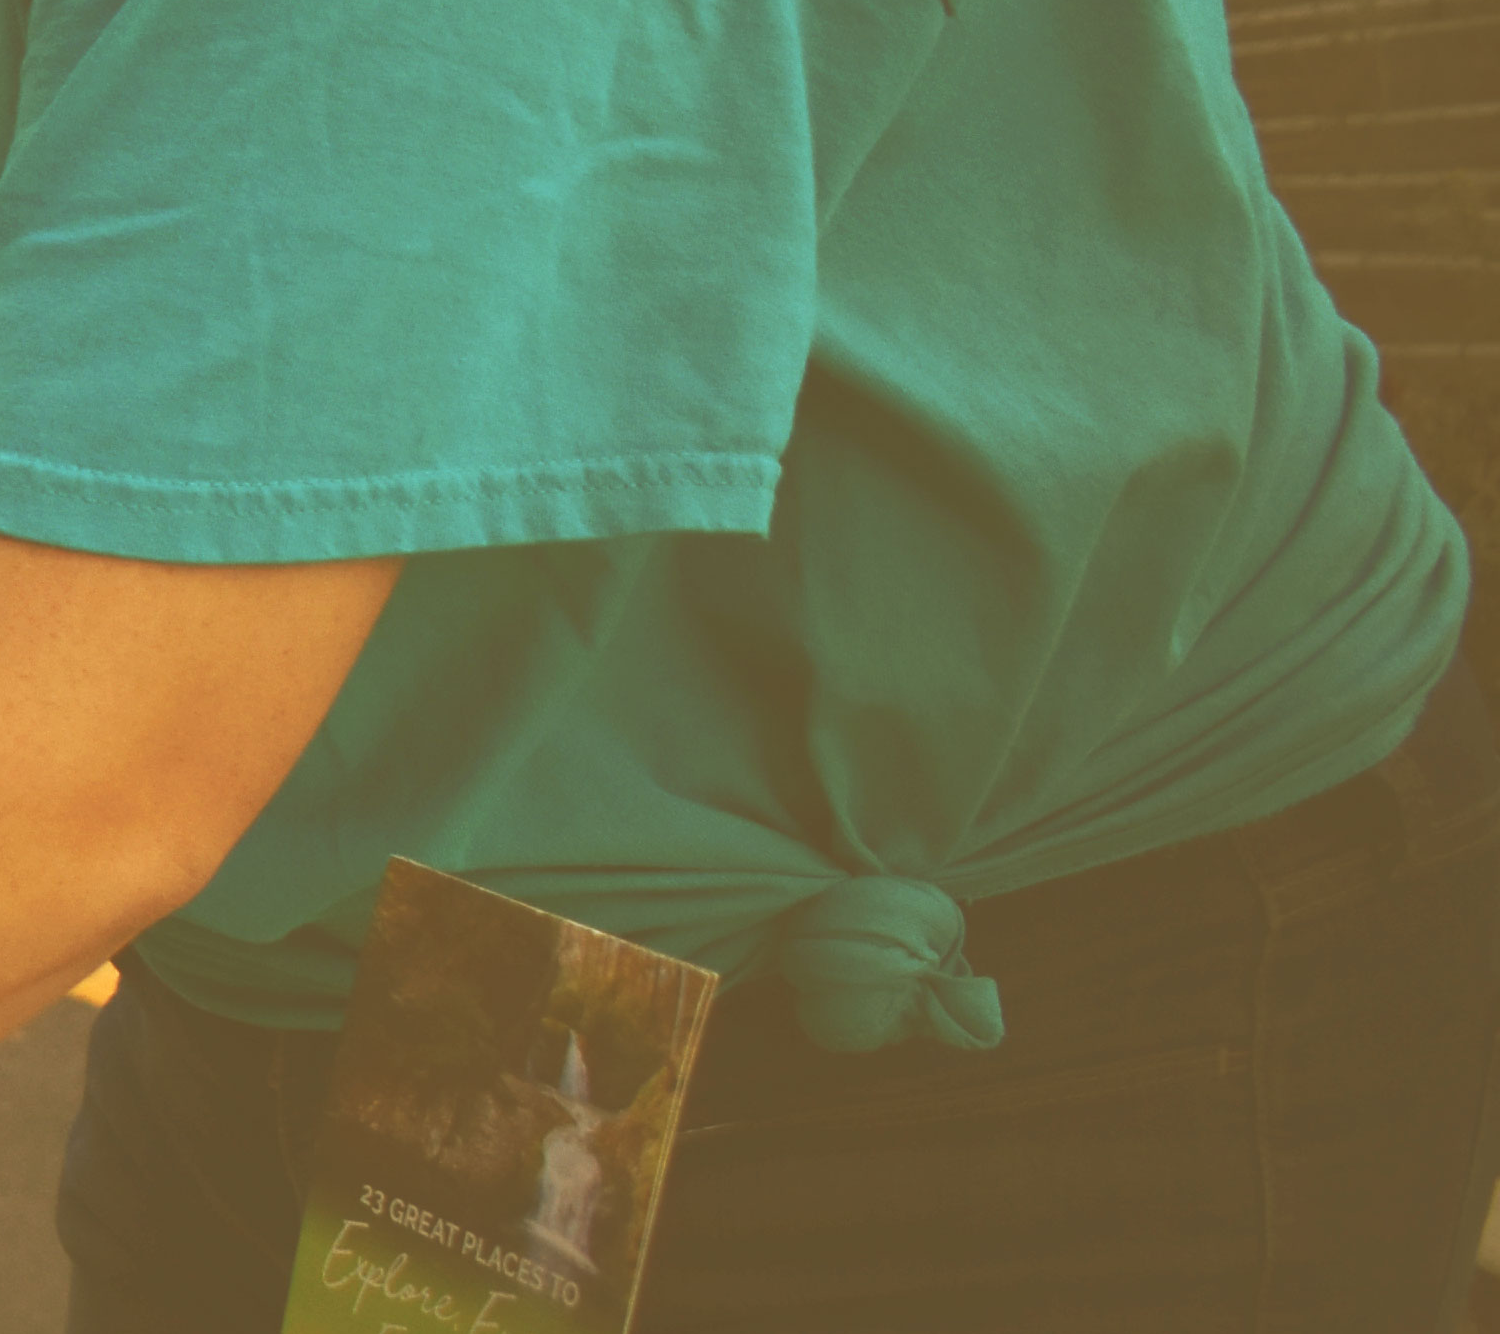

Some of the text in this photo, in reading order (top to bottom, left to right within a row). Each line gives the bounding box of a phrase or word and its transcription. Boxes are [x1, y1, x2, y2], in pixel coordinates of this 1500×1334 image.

[359, 1182, 581, 1308] 23 GREAT PLACES TO
